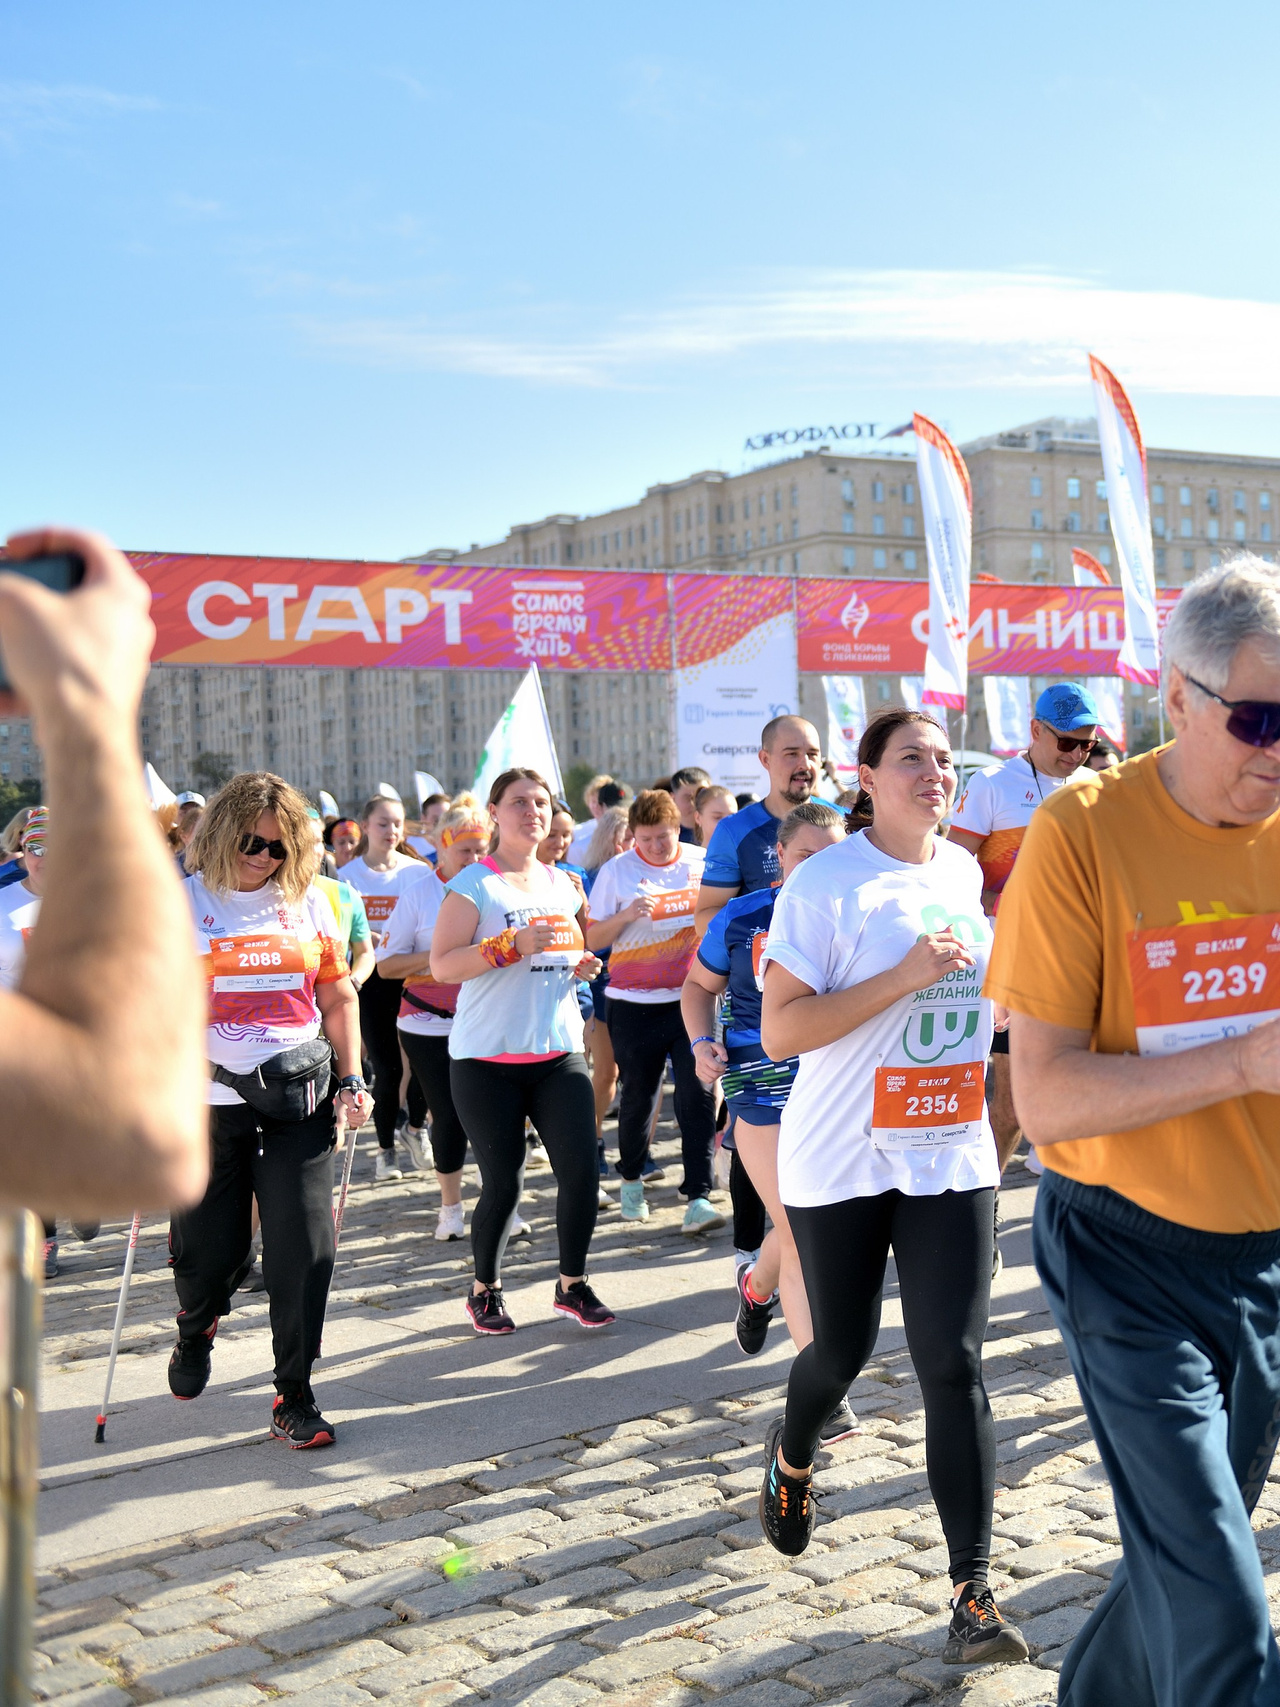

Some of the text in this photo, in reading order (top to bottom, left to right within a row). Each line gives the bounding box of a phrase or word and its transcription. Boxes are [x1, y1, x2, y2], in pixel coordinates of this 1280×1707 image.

[745, 423, 881, 450] АЭРОФЛОТ
[187, 580, 473, 645] СТАРТ
[822, 642, 890, 653] ФОНД БОРЬБЫ
[832, 652, 891, 663] ЛЕЙКЕМИЕЙ
[702, 743, 762, 757] Северста
[664, 900, 690, 914] 2367
[238, 952, 282, 968] 2088
[1182, 962, 1267, 1004] 2239
[913, 985, 983, 1003] ЖЕЛАНИИ
[905, 1093, 959, 1116] 2356
[941, 1129, 967, 1137] Северсталь
